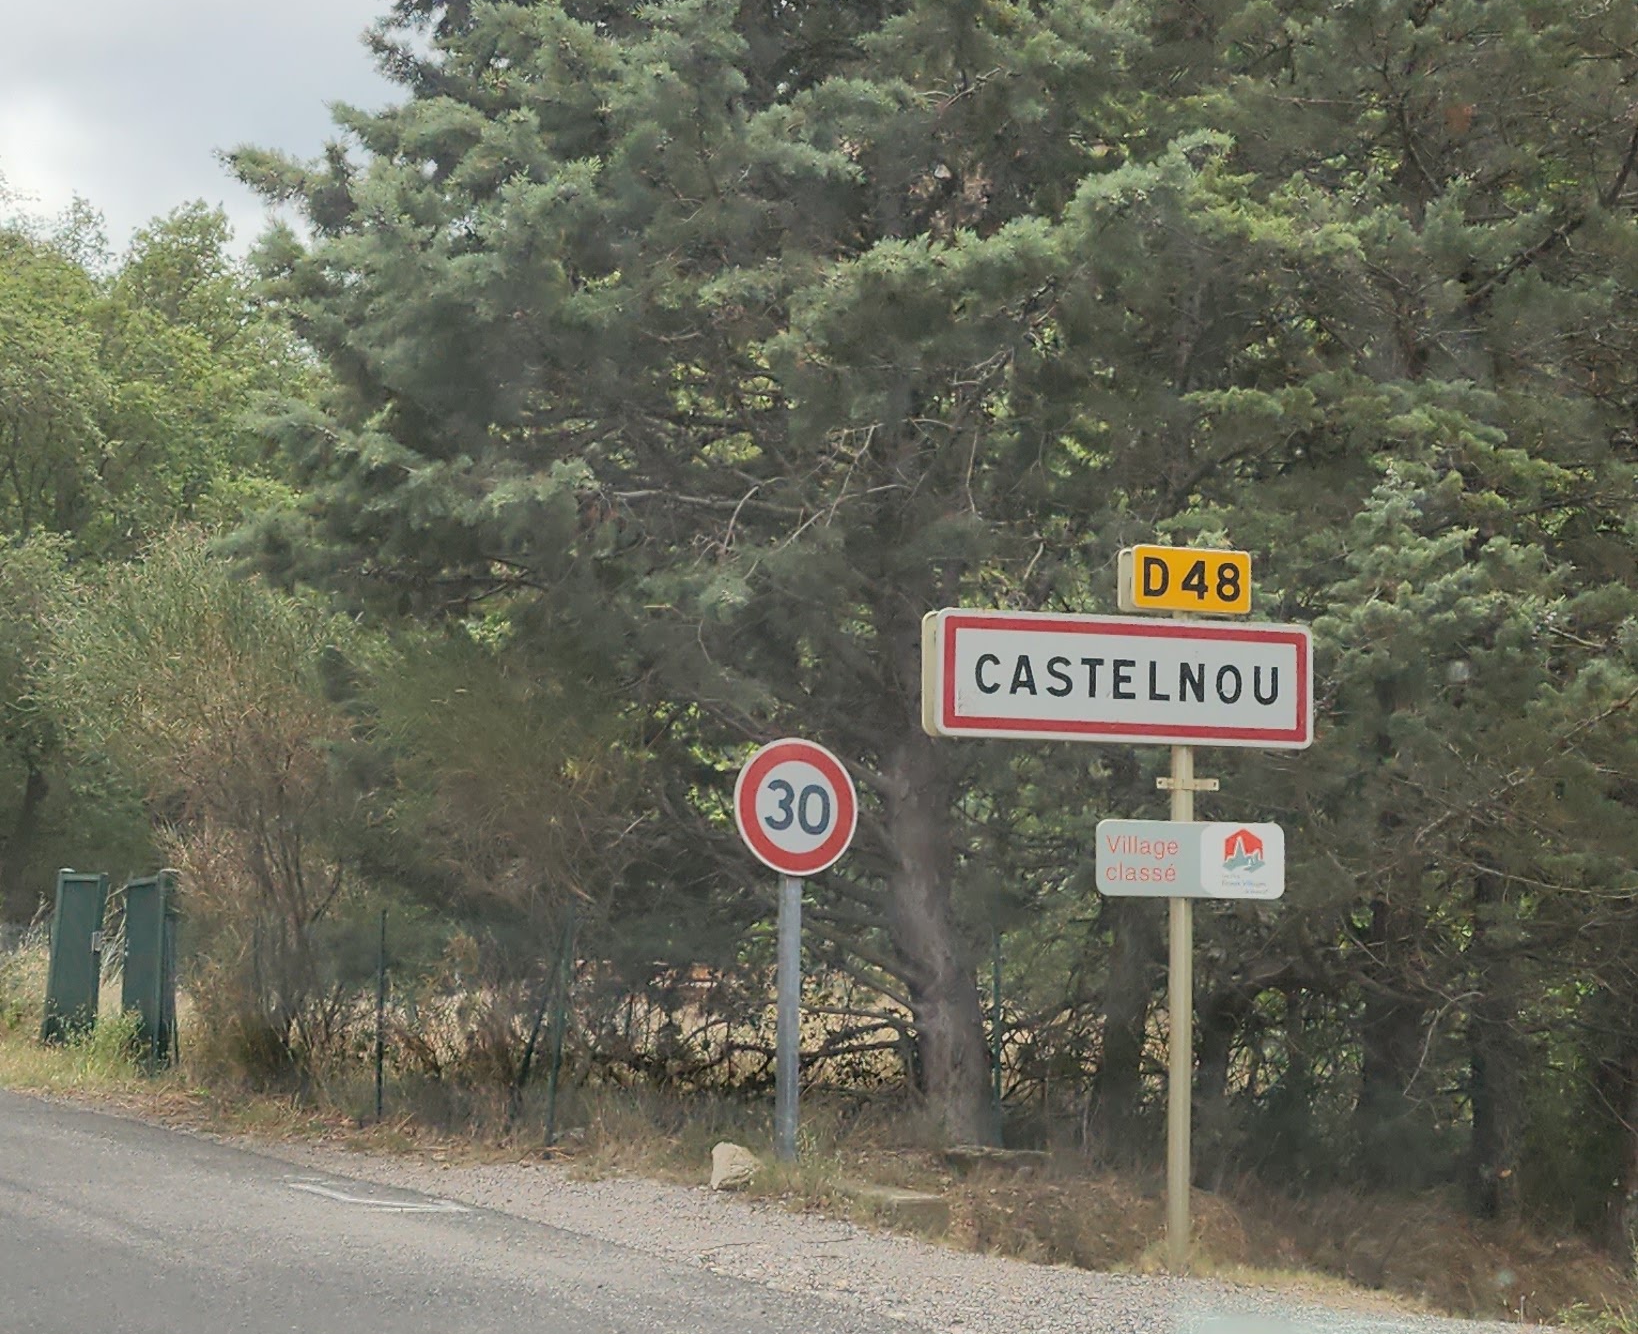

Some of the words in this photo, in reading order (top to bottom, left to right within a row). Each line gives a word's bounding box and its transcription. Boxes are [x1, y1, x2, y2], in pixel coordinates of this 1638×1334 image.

[973, 653, 1279, 705] CASTELNOU
[764, 779, 831, 836] 30
[1106, 835, 1179, 860] Village
[1105, 862, 1176, 882] classé
